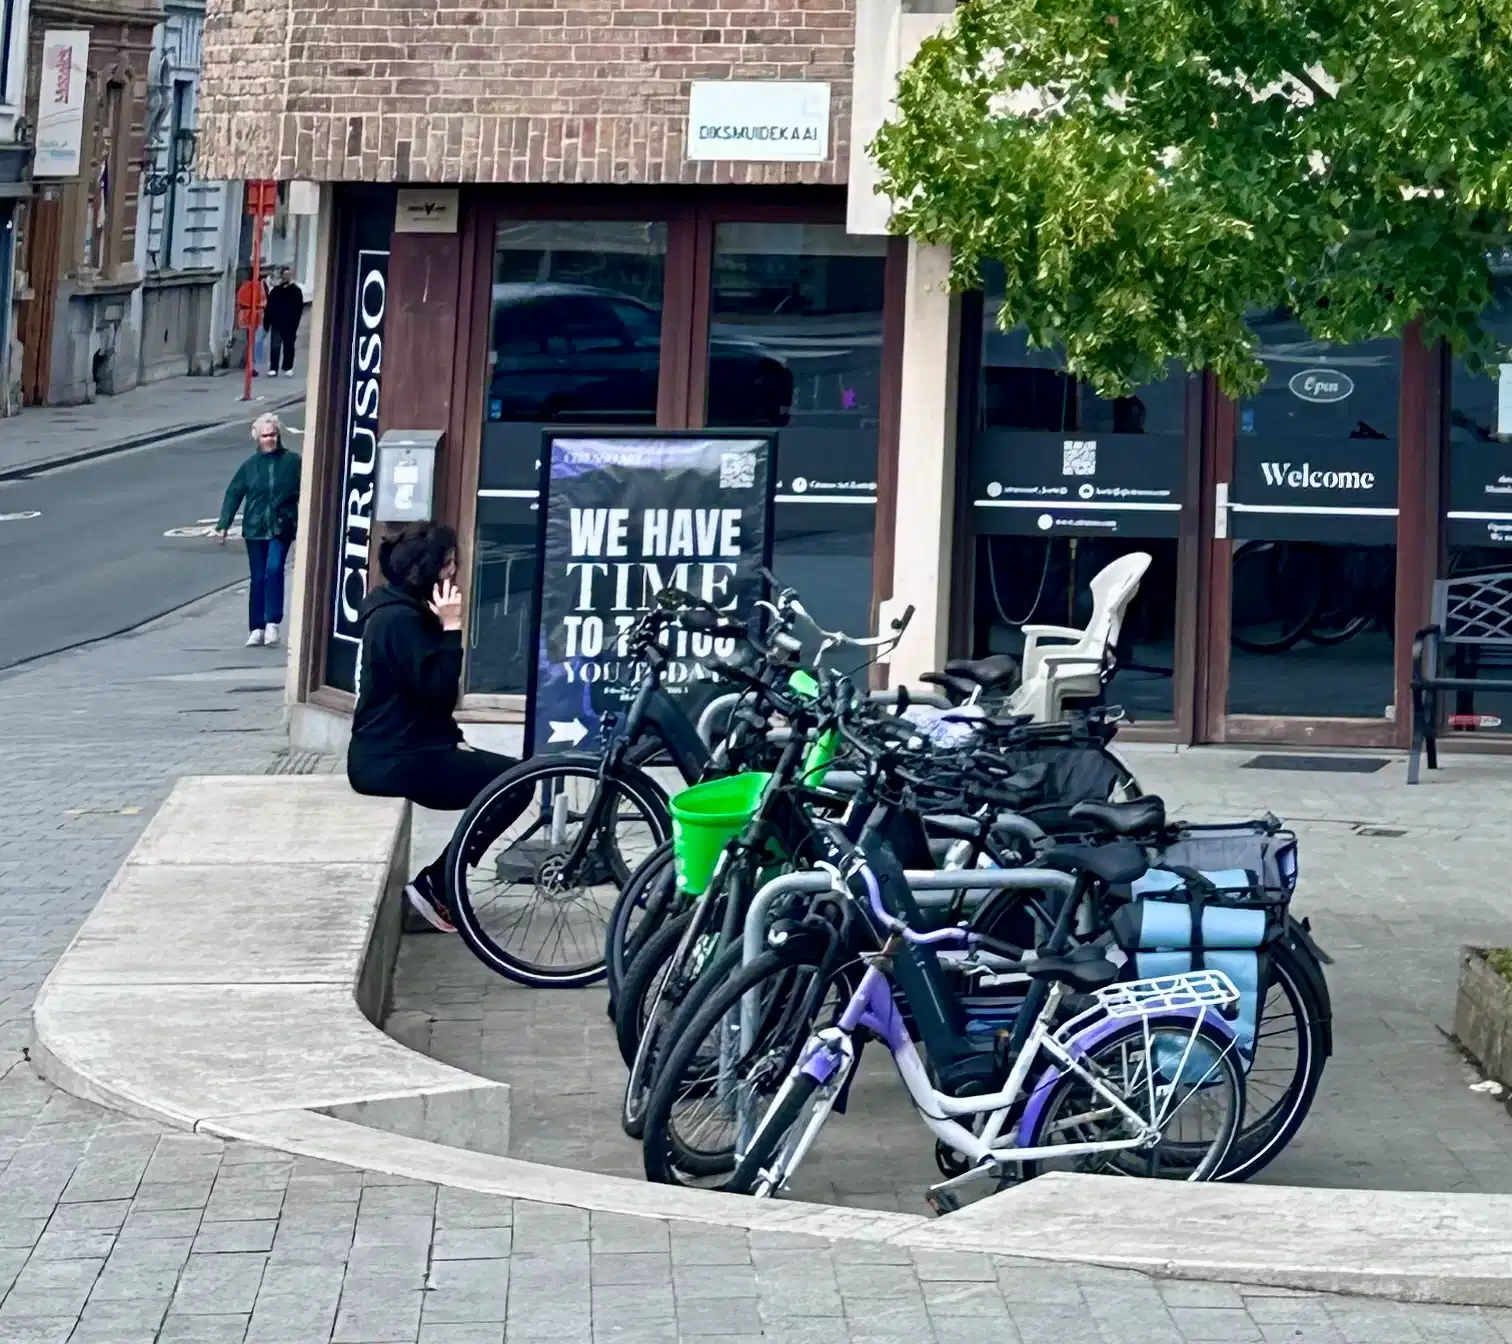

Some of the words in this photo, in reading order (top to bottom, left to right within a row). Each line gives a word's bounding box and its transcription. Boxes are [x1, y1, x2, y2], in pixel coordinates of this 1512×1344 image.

[1303, 376, 1339, 396] Open
[342, 269, 386, 623] CIRUSSO
[1260, 462, 1375, 489] Welcome
[570, 508, 629, 557] WE
[642, 508, 742, 557] HAVE
[565, 562, 738, 612] TIME
[563, 615, 603, 658] TO
[563, 661, 621, 684] YOU
